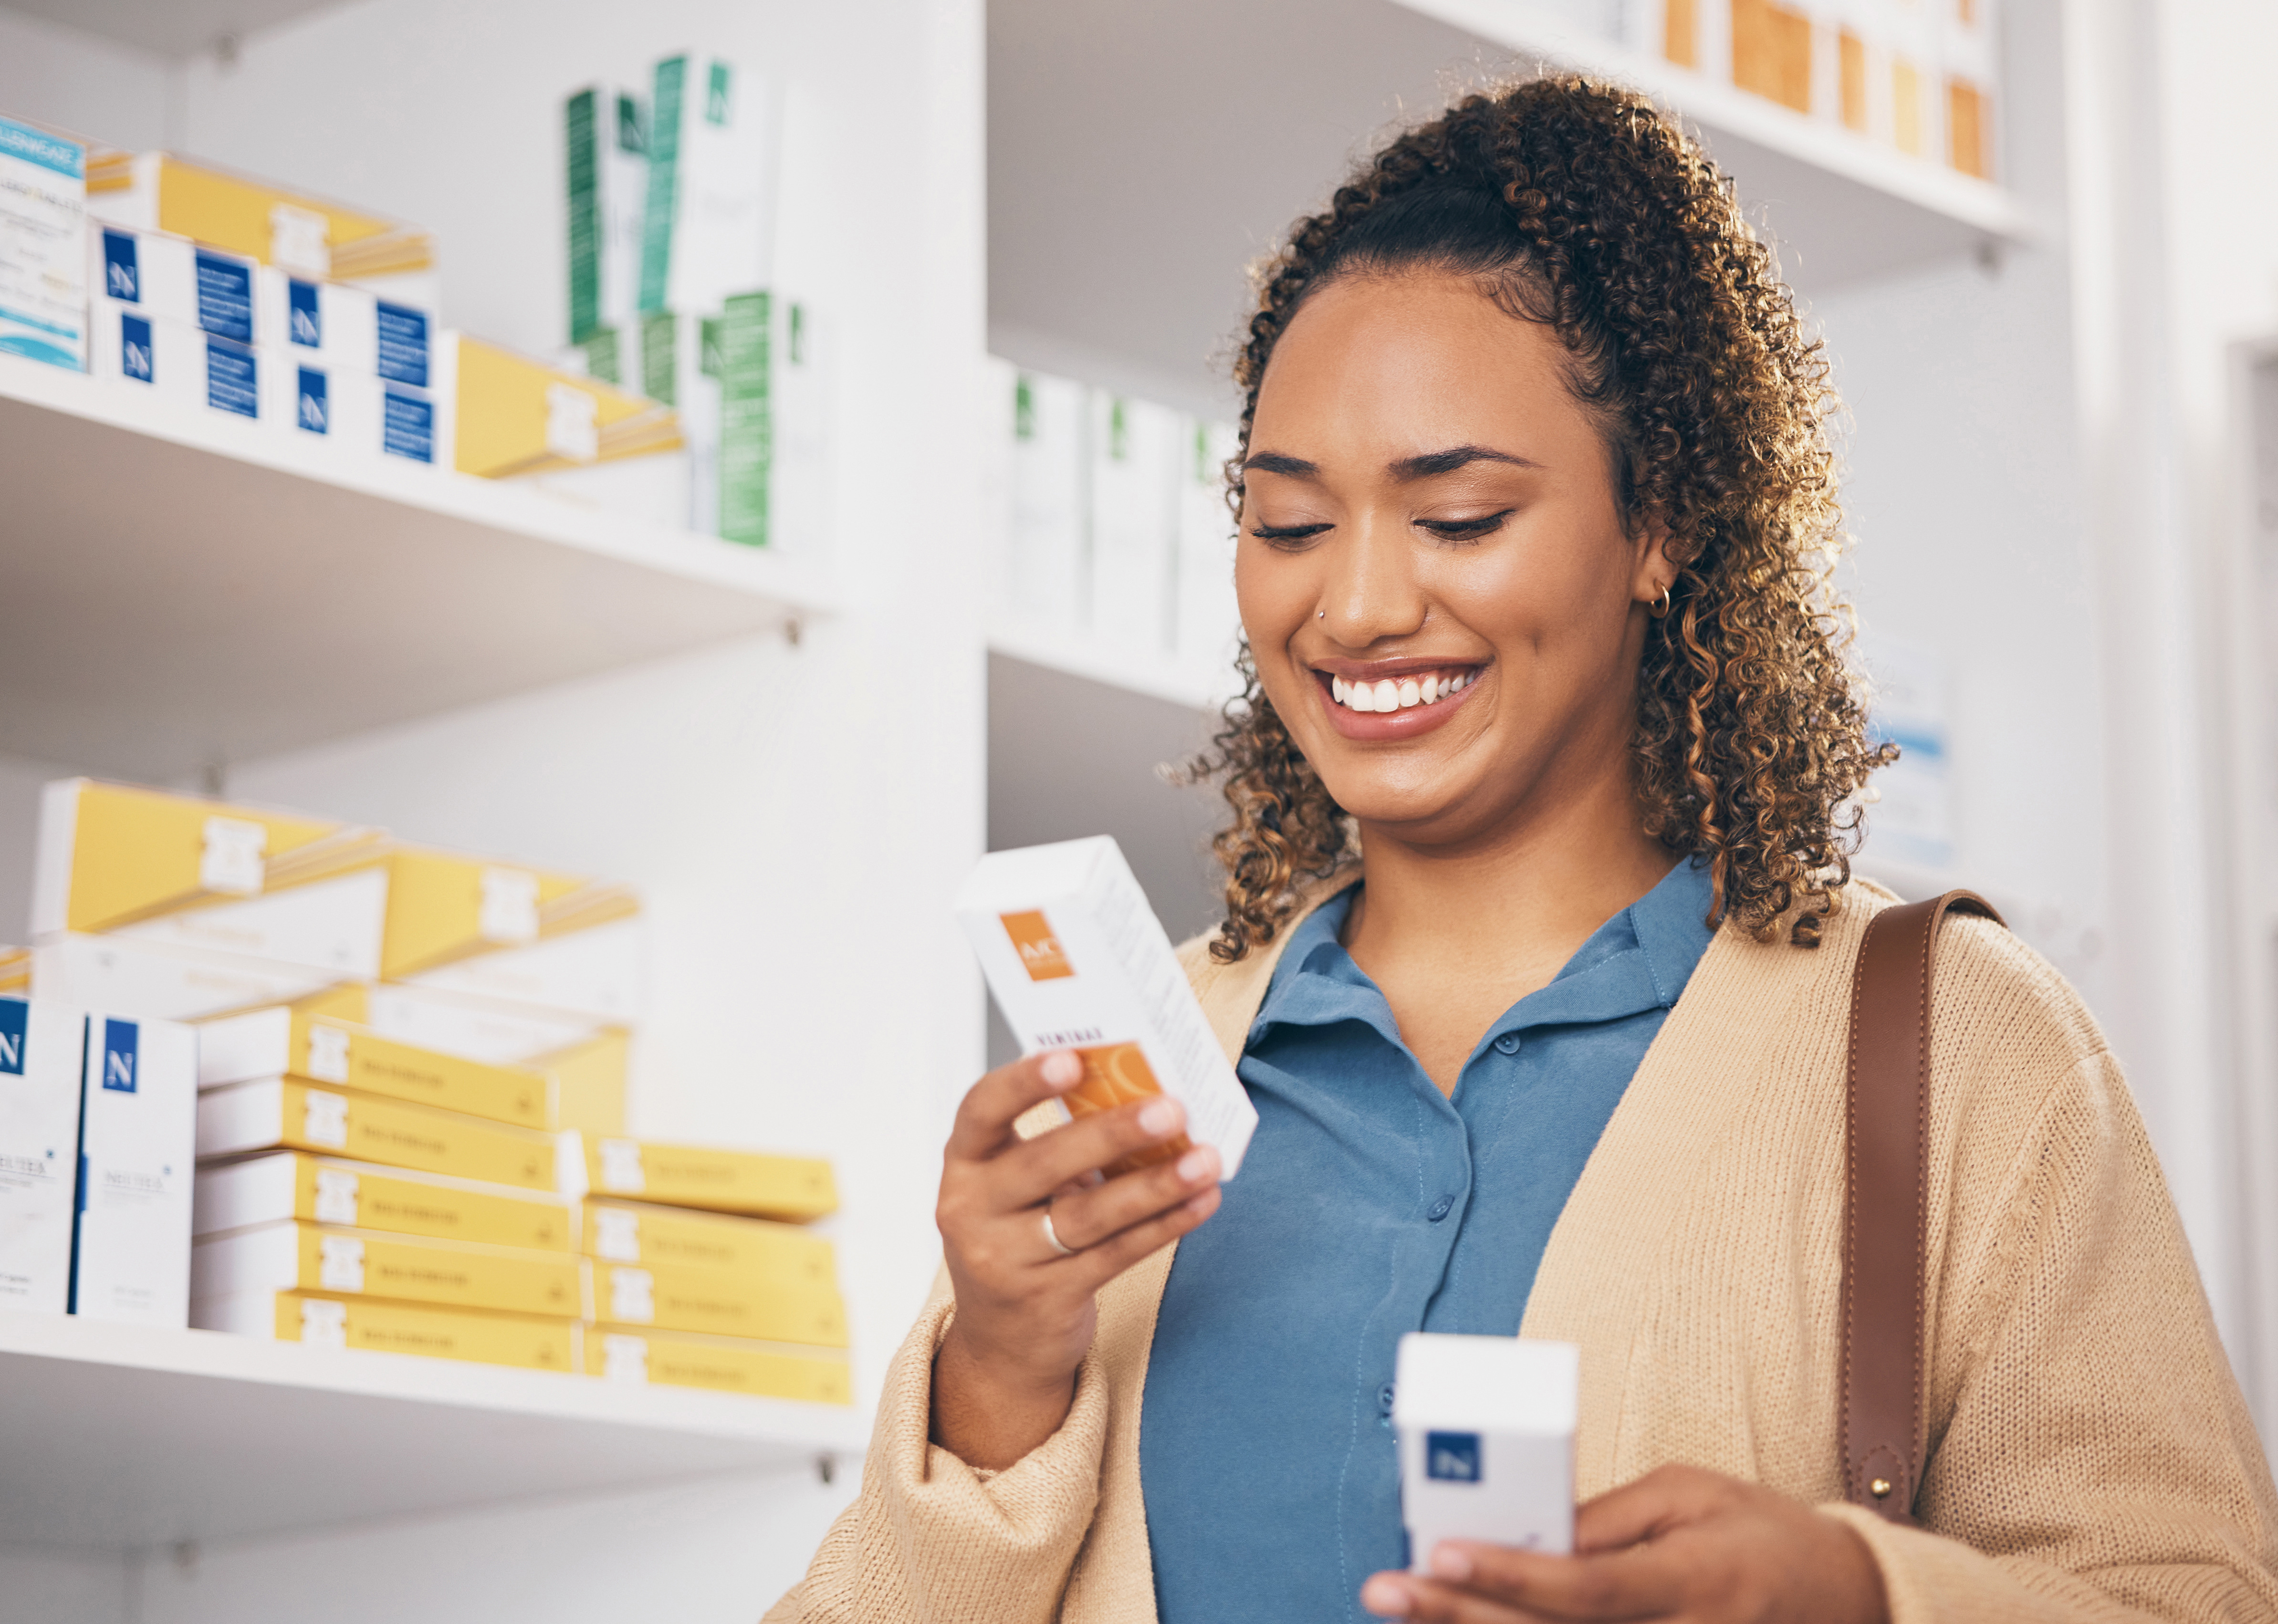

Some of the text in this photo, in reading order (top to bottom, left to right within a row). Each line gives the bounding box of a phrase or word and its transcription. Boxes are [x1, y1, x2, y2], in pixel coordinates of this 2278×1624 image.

[108, 260, 136, 300] N
[291, 306, 319, 347] N
[125, 340, 150, 376] N
[301, 392, 327, 434] N
[0, 1031, 21, 1068] N
[106, 1050, 133, 1087] N
